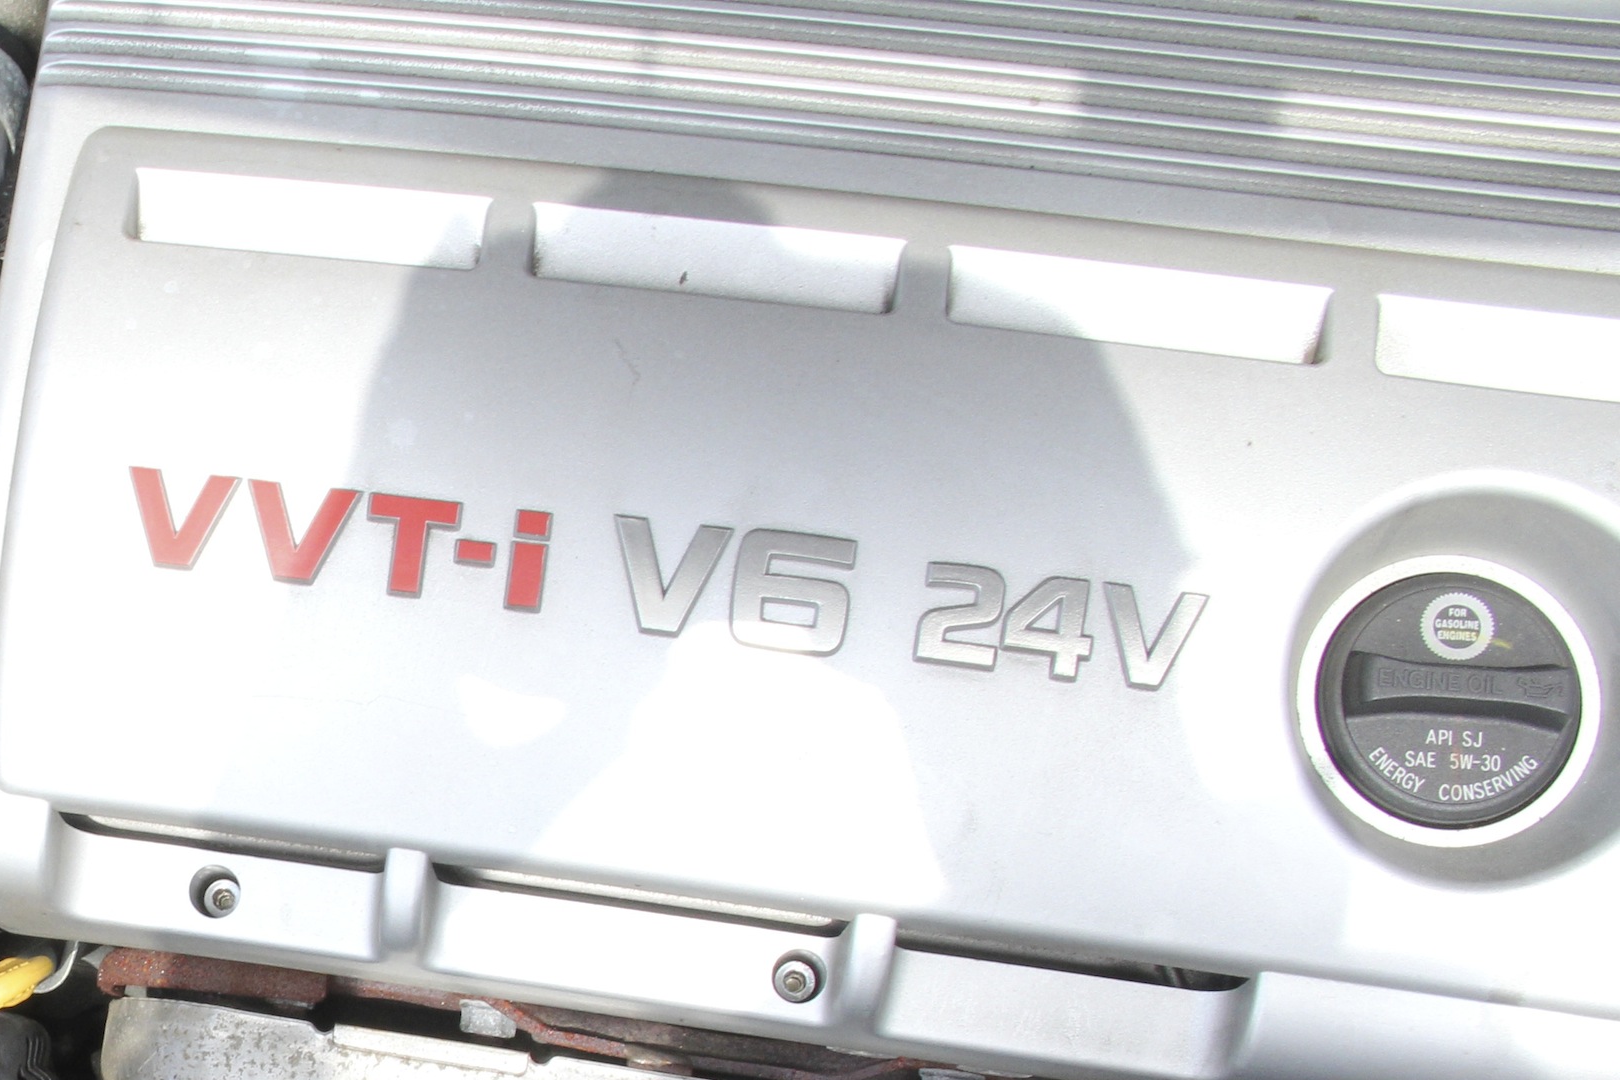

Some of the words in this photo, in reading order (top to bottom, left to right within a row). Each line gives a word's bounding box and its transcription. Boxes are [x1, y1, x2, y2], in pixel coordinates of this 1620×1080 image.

[129, 466, 554, 613] VVT-i
[613, 513, 858, 657] V6
[913, 560, 1210, 691] 24V
[1448, 607, 1467, 617] FOR
[1435, 618, 1479, 630] GASOLINE
[1437, 630, 1477, 641] ENGINES
[1378, 667, 1461, 692] ENGINE
[1467, 677, 1503, 695] OIL
[1425, 729, 1453, 745] API
[1462, 731, 1483, 748] SJ
[1405, 751, 1436, 768] SAE
[1449, 753, 1501, 771] 5W-30
[1369, 747, 1425, 794] ENERGY
[1438, 755, 1539, 801] CONSERVING
